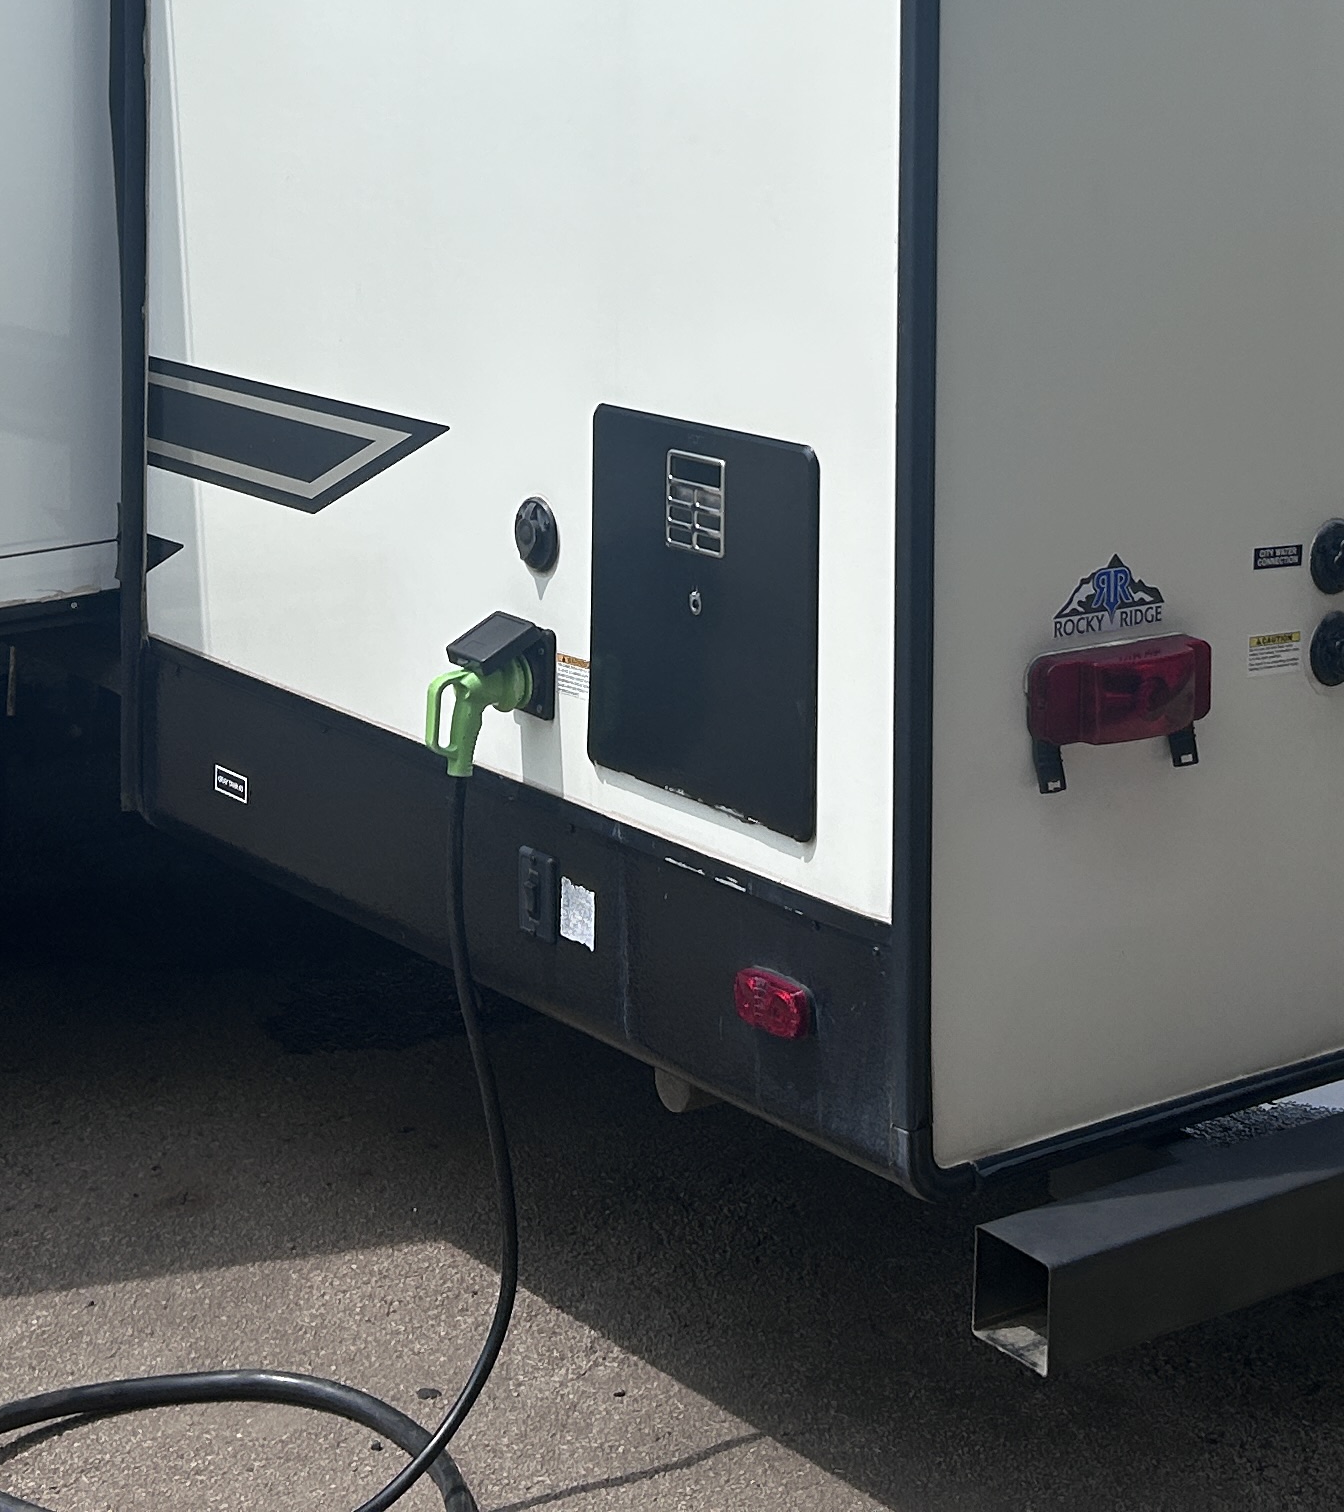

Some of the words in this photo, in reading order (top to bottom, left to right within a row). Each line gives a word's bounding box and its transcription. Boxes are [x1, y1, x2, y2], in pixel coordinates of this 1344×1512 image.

[1259, 549, 1274, 559] CITY
[1275, 546, 1298, 557] WATER
[1257, 555, 1299, 567] CONNECTION
[1053, 614, 1105, 638] ROCKY
[1119, 605, 1163, 628] RIDGE
[1262, 633, 1294, 645] CAUTION
